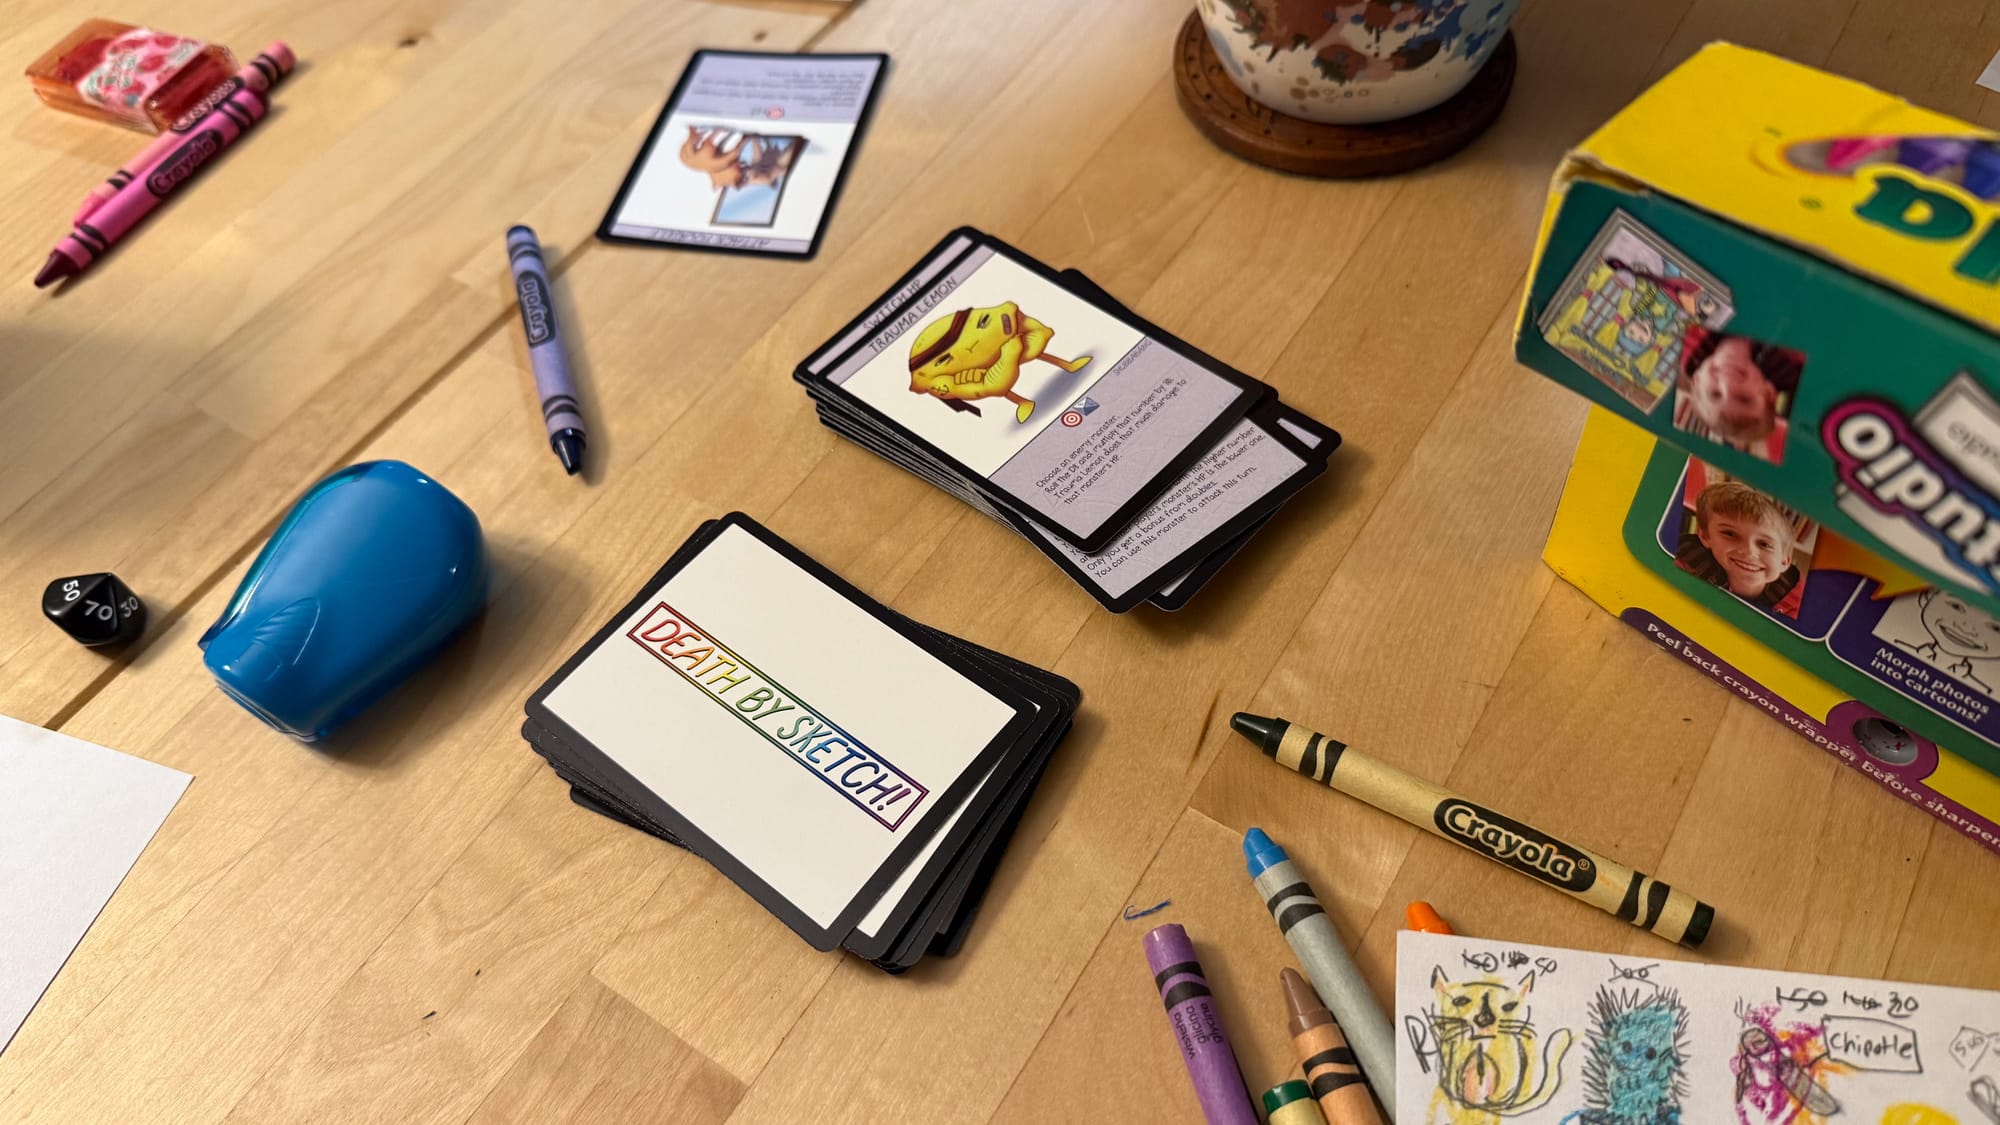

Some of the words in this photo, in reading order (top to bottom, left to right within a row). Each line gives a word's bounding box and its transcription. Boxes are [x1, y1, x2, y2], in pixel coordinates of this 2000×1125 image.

[152, 136, 216, 192] Crayola
[521, 278, 549, 343] Crayola
[863, 291, 909, 331] SWITCH
[869, 311, 918, 353] TRAUMA
[918, 276, 957, 313] LEMON
[1036, 467, 1063, 489] Choose
[1060, 459, 1072, 469] an
[1069, 439, 1093, 460] enemy
[1044, 480, 1060, 494] Roll
[1057, 471, 1071, 483] the
[1078, 450, 1094, 466] and
[1092, 428, 1120, 455] multiply
[1116, 416, 1132, 430] that
[1131, 393, 1156, 417] number
[1153, 384, 1166, 394] by
[1053, 473, 1083, 501] Trauma
[1080, 456, 1106, 476] Lemon
[1103, 440, 1121, 456] does
[1119, 427, 1135, 441] that
[1135, 412, 1153, 428] much
[1149, 386, 1179, 414] damage
[1176, 379, 1187, 387] to
[1195, 471, 1208, 483] HP
[1213, 457, 1229, 472] the
[1226, 444, 1249, 462] lower
[1201, 446, 1226, 468] higher
[1226, 427, 1255, 449] number
[1064, 490, 1080, 504] that
[1838, 413, 2000, 582] tudio
[1087, 554, 1106, 572] Only
[1104, 544, 1121, 560] you
[1118, 536, 1135, 552] get
[1139, 515, 1166, 533] bonus
[1164, 499, 1186, 519] from
[1094, 564, 1113, 580] You
[1110, 554, 1128, 569] can
[1126, 544, 1142, 557] use
[1141, 532, 1157, 548] this
[1156, 513, 1187, 538] monster
[1187, 507, 1198, 516] to
[1222, 479, 1238, 490] this
[63, 580, 80, 602] 50
[85, 600, 113, 620] 70
[120, 596, 138, 618] 30
[1869, 656, 1903, 682] into
[1904, 675, 1982, 723] cartoons!
[1876, 646, 1931, 683] Morph
[1931, 676, 1990, 714] photos
[641, 619, 751, 694] DEATH
[736, 687, 795, 720] BY
[777, 715, 911, 811] SKETCH!
[1646, 622, 1681, 651] Peel
[1682, 642, 1722, 678] back
[1723, 674, 1780, 716] crayon
[1783, 712, 1856, 763] wrapper
[1860, 760, 1923, 802] before
[1186, 1004, 1210, 1045] glicina
[1200, 1002, 1225, 1045] glycine
[1829, 1031, 1913, 1059] Chipotle
